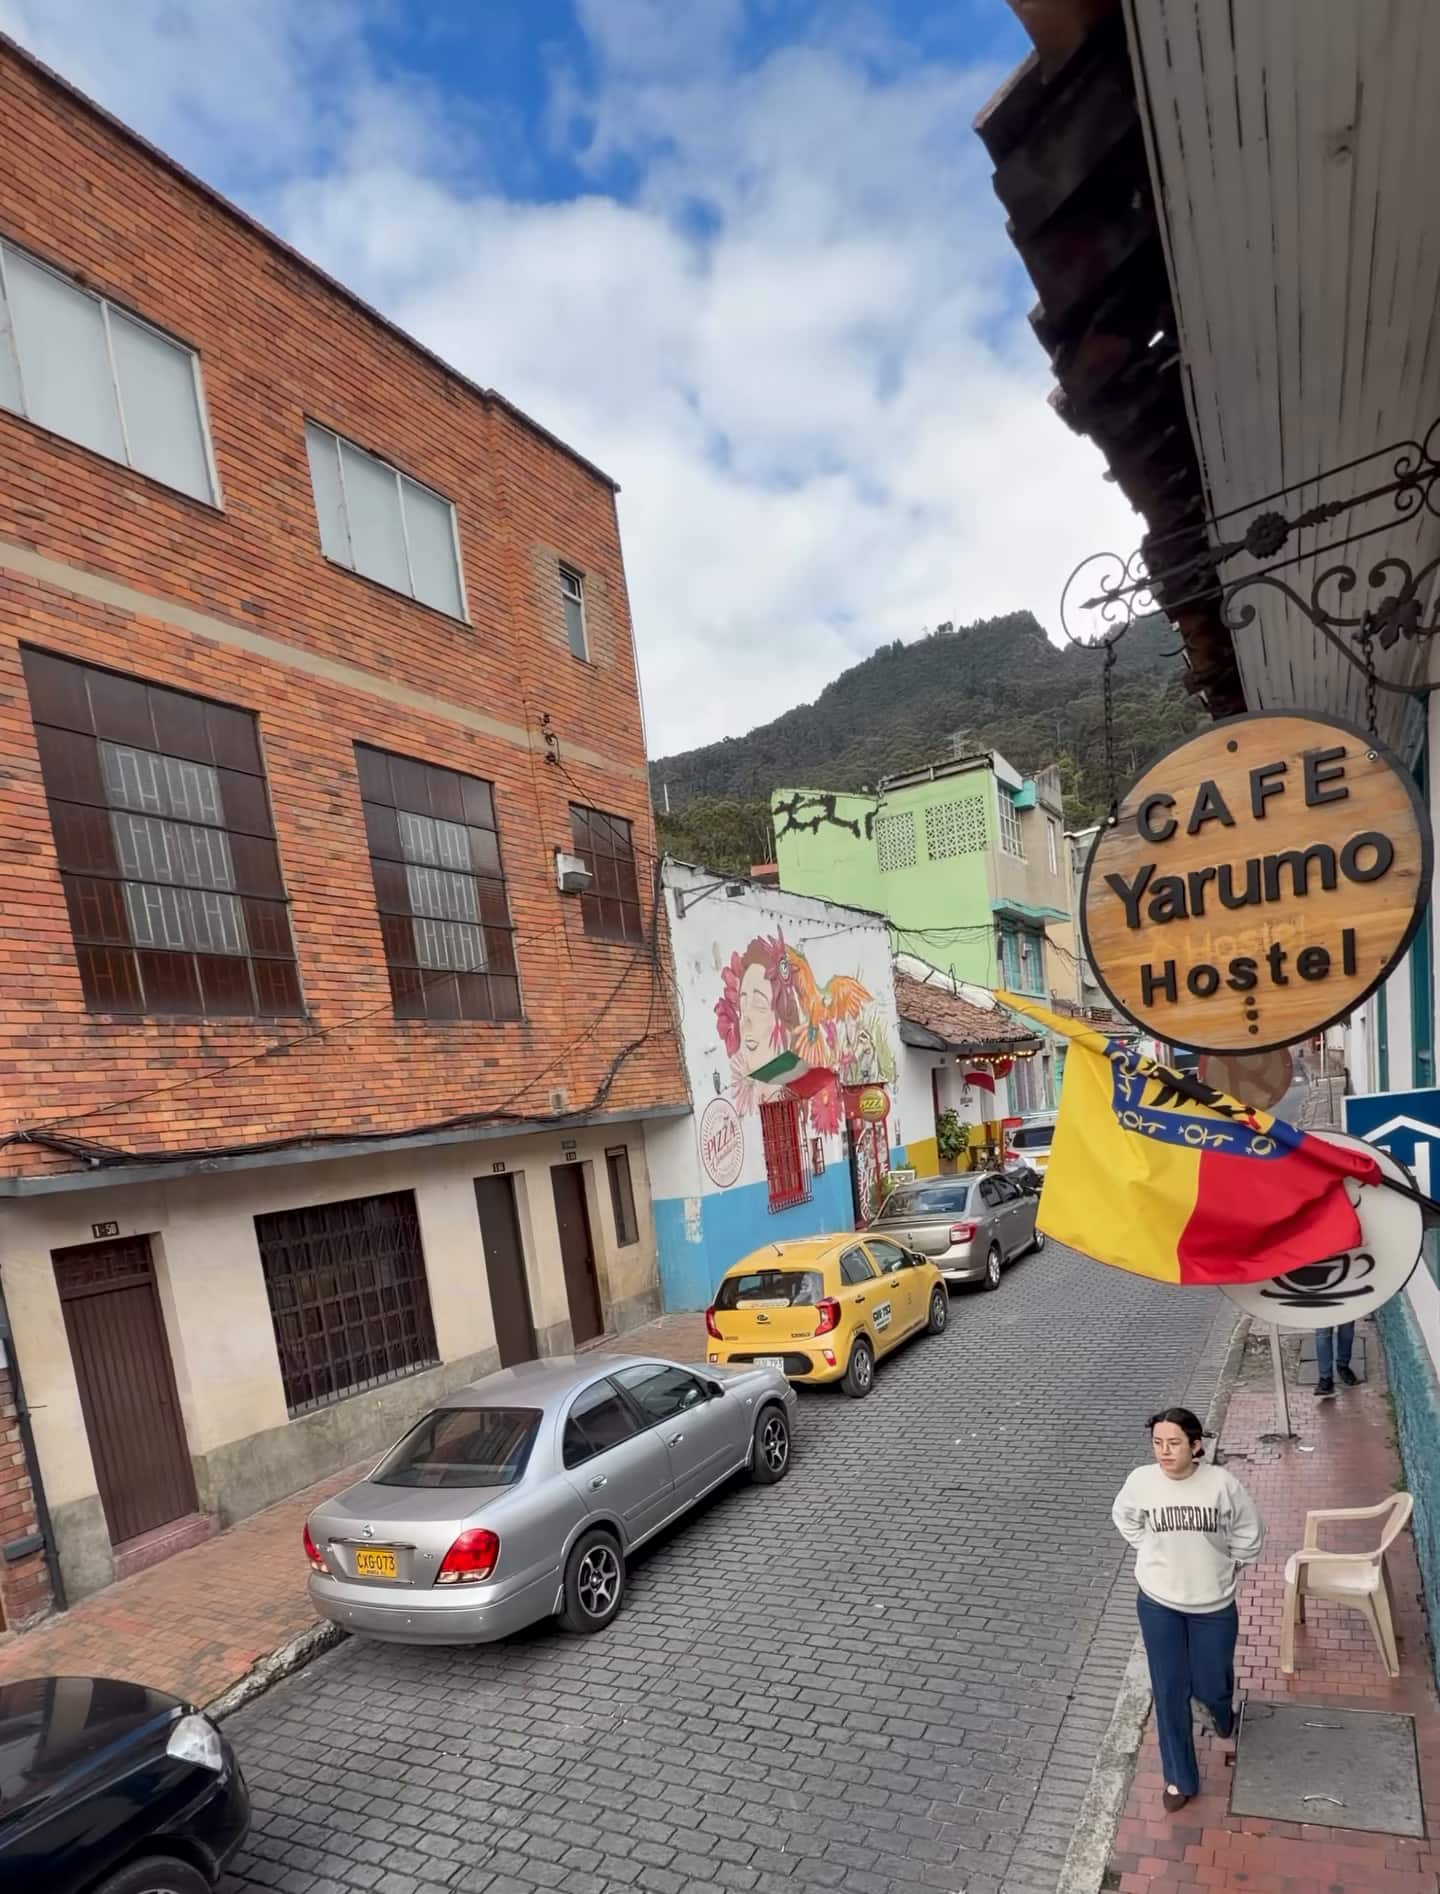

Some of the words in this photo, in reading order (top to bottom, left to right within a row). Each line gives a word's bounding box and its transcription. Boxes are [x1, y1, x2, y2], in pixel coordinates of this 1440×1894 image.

[1136, 746, 1349, 843] CAFE
[1104, 831, 1394, 930] Yarumo
[1140, 928, 1357, 1007] Hostel
[707, 1119, 736, 1161] PIZZA
